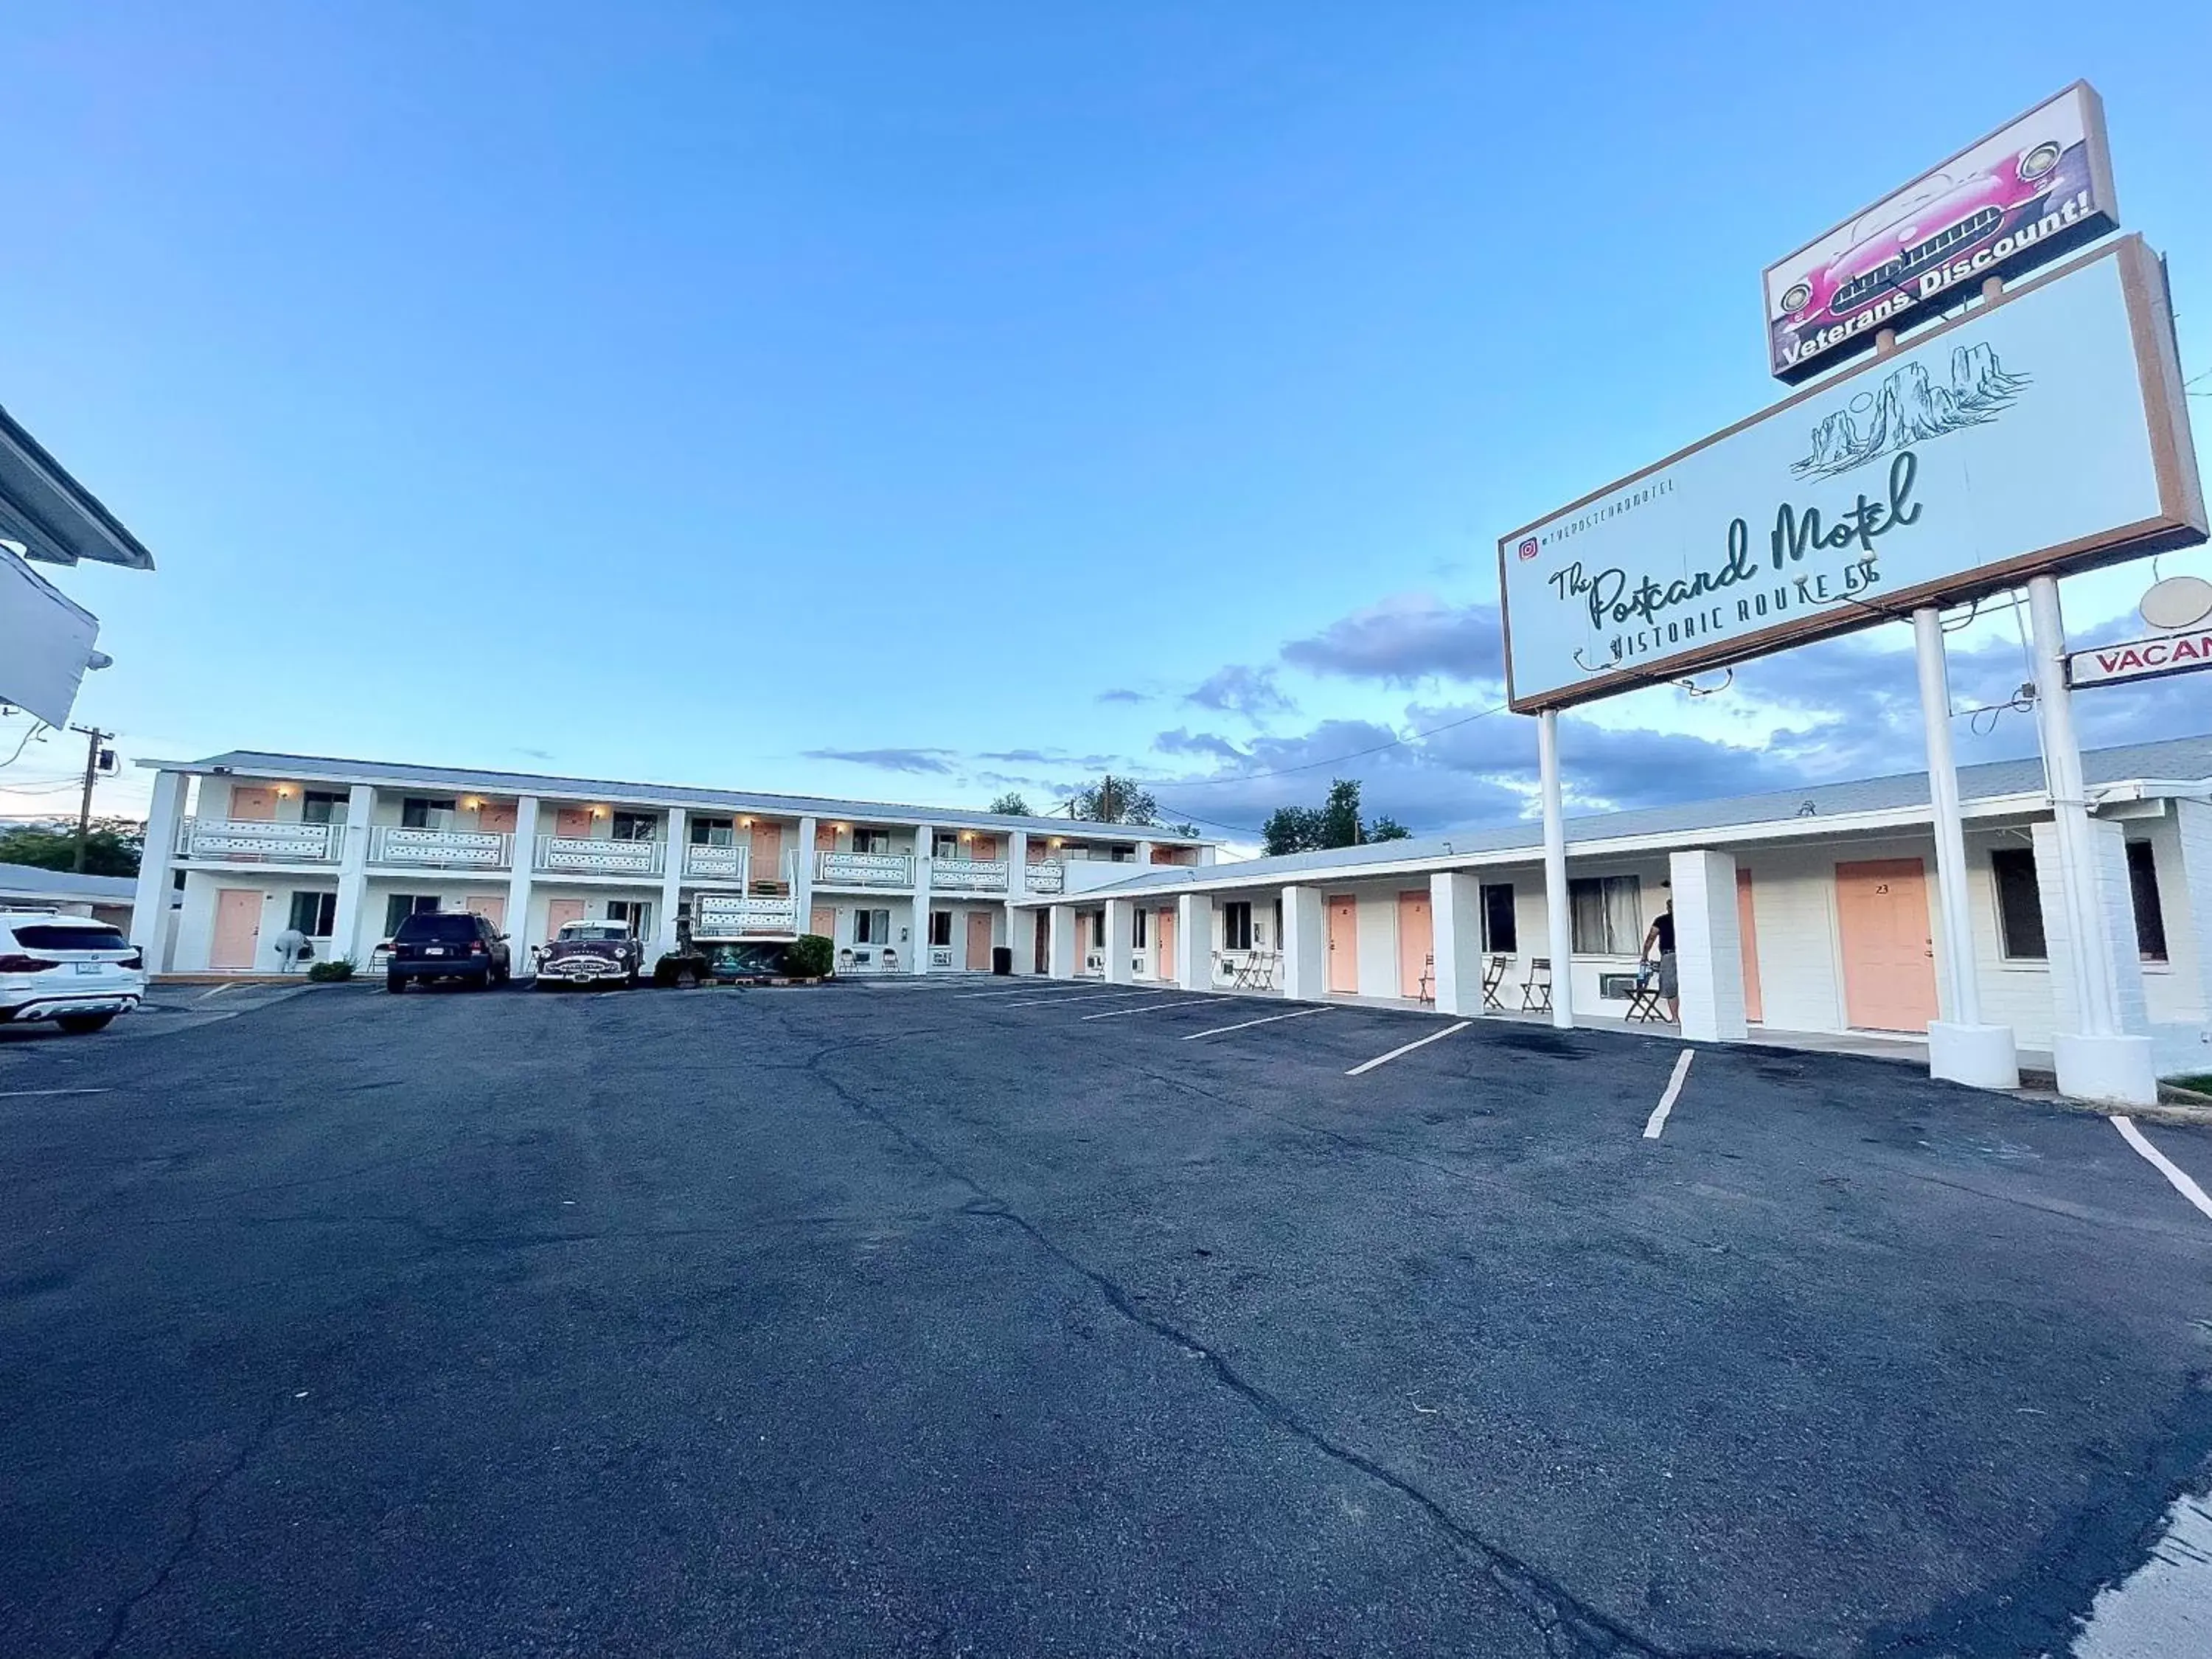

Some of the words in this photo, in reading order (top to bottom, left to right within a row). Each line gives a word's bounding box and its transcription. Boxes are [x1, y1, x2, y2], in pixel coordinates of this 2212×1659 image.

[1782, 294, 1911, 366] Veterans
[1919, 193, 2092, 298] Discount!
[1548, 561, 1591, 600] The
[1588, 518, 1759, 630] Postcard
[1771, 451, 1923, 569] Motel
[1876, 884, 1888, 894] 23
